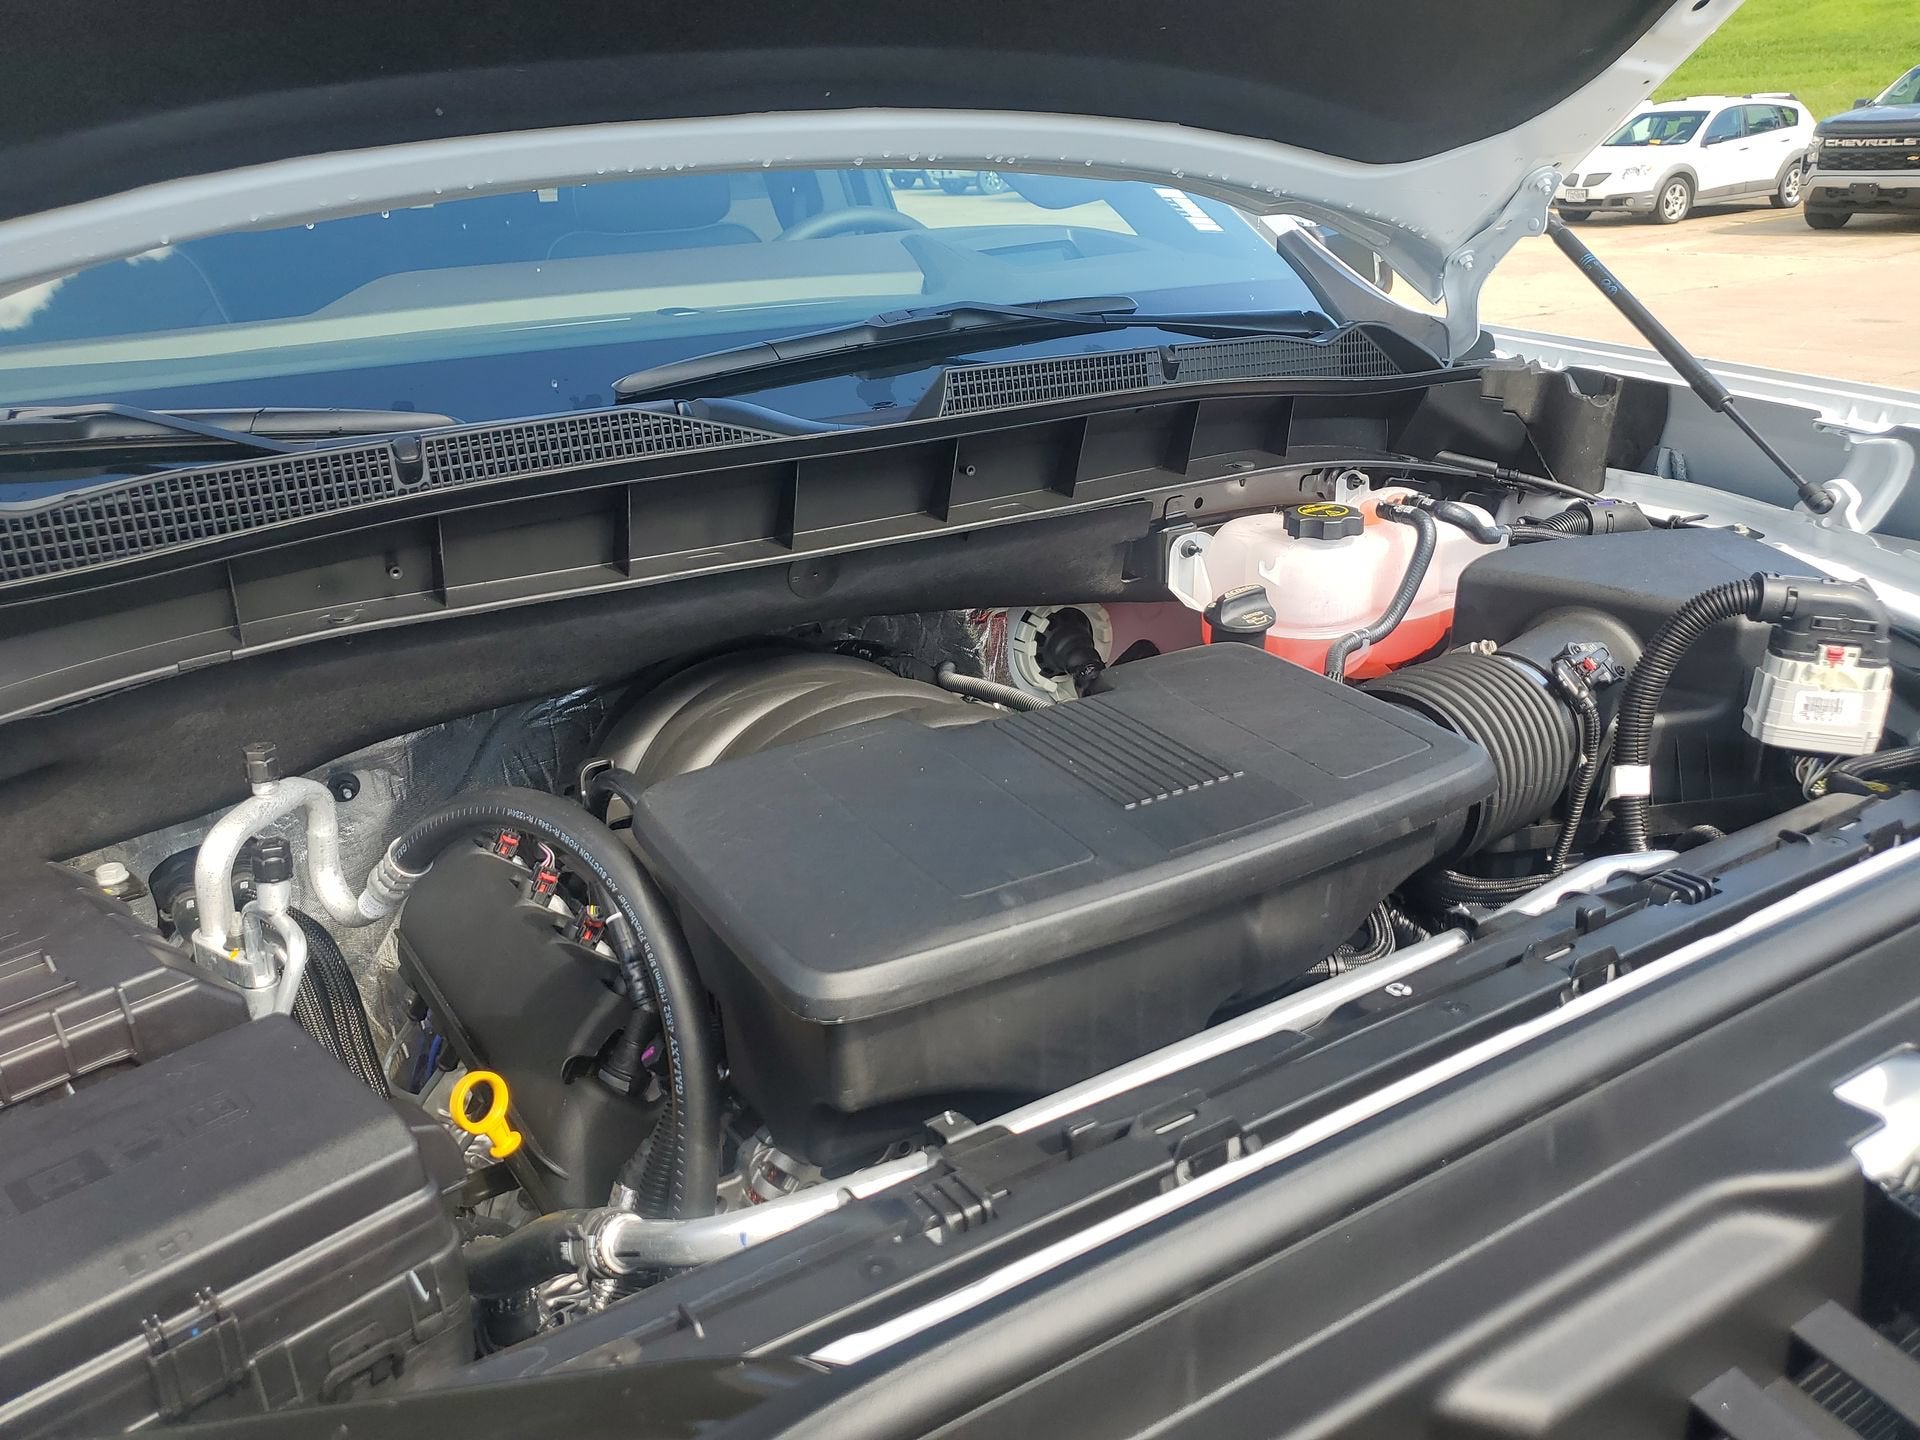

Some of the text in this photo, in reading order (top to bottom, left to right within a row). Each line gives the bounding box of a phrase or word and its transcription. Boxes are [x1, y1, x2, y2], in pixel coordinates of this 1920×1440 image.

[560, 832, 580, 851] HOSE
[580, 847, 608, 879] SUCTION
[670, 1036, 684, 1095] GALAXY
